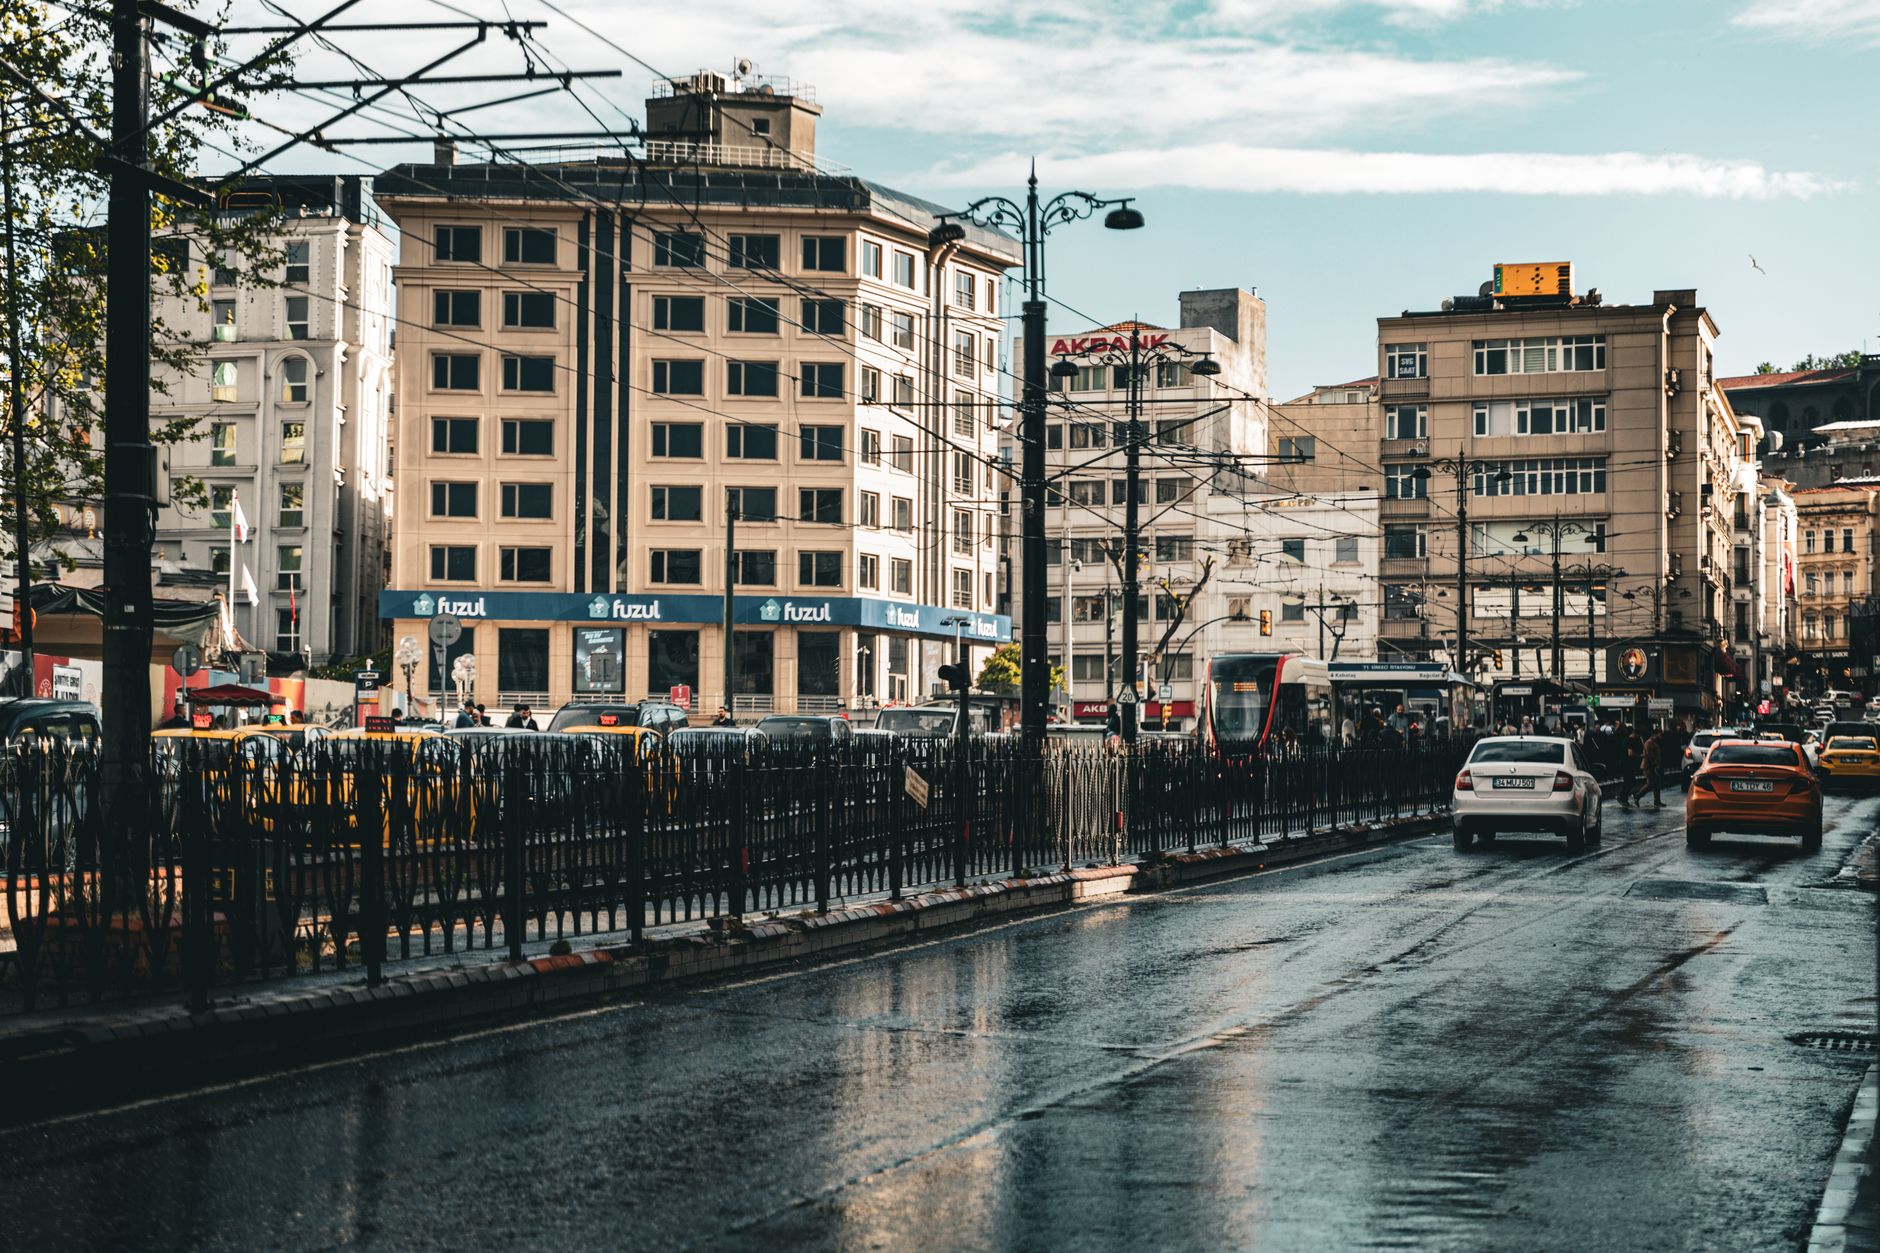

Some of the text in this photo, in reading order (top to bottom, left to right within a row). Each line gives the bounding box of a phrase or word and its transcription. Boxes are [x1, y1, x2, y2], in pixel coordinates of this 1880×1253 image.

[1051, 334, 1168, 355] AKBANK
[438, 596, 487, 617] fuzul
[612, 599, 661, 619] fuzul
[784, 601, 832, 622] fuzul
[897, 607, 919, 629] fuzul
[977, 618, 998, 638] fuzul
[1123, 693, 1133, 701] 20
